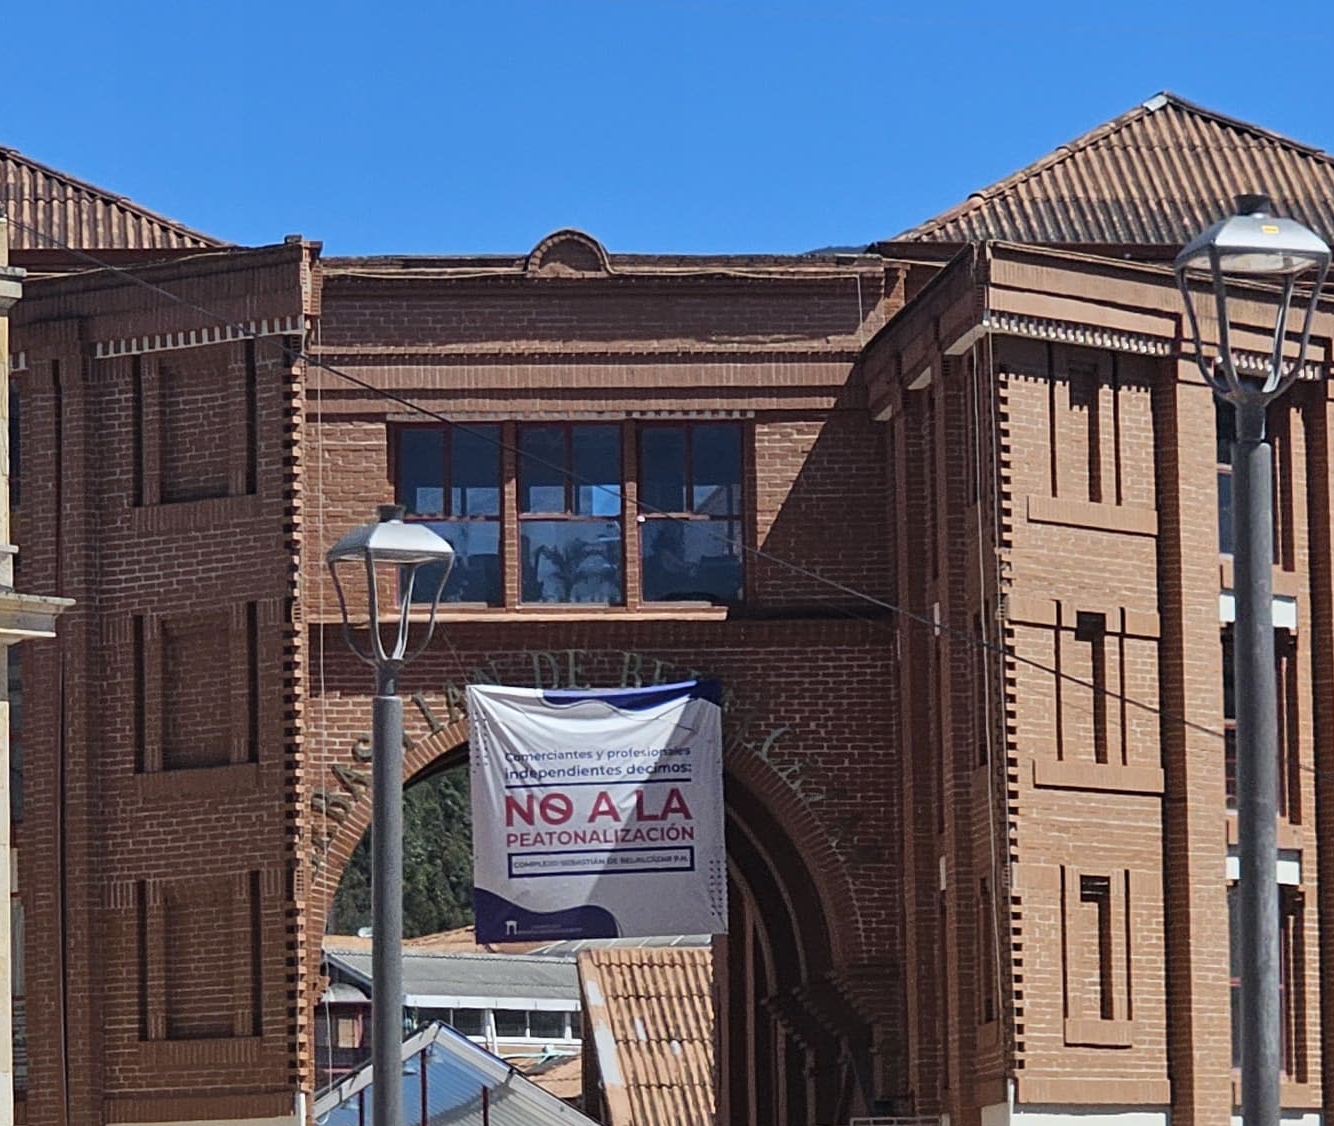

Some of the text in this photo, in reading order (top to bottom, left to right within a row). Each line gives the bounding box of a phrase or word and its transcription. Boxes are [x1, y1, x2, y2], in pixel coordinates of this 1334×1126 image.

[505, 750, 593, 763] Comerciantes
[607, 746, 692, 760] profesionales
[505, 762, 693, 781] independientes decimos:
[505, 787, 694, 827] NO A LA
[506, 822, 695, 849] PEATONALIZACIÓN
